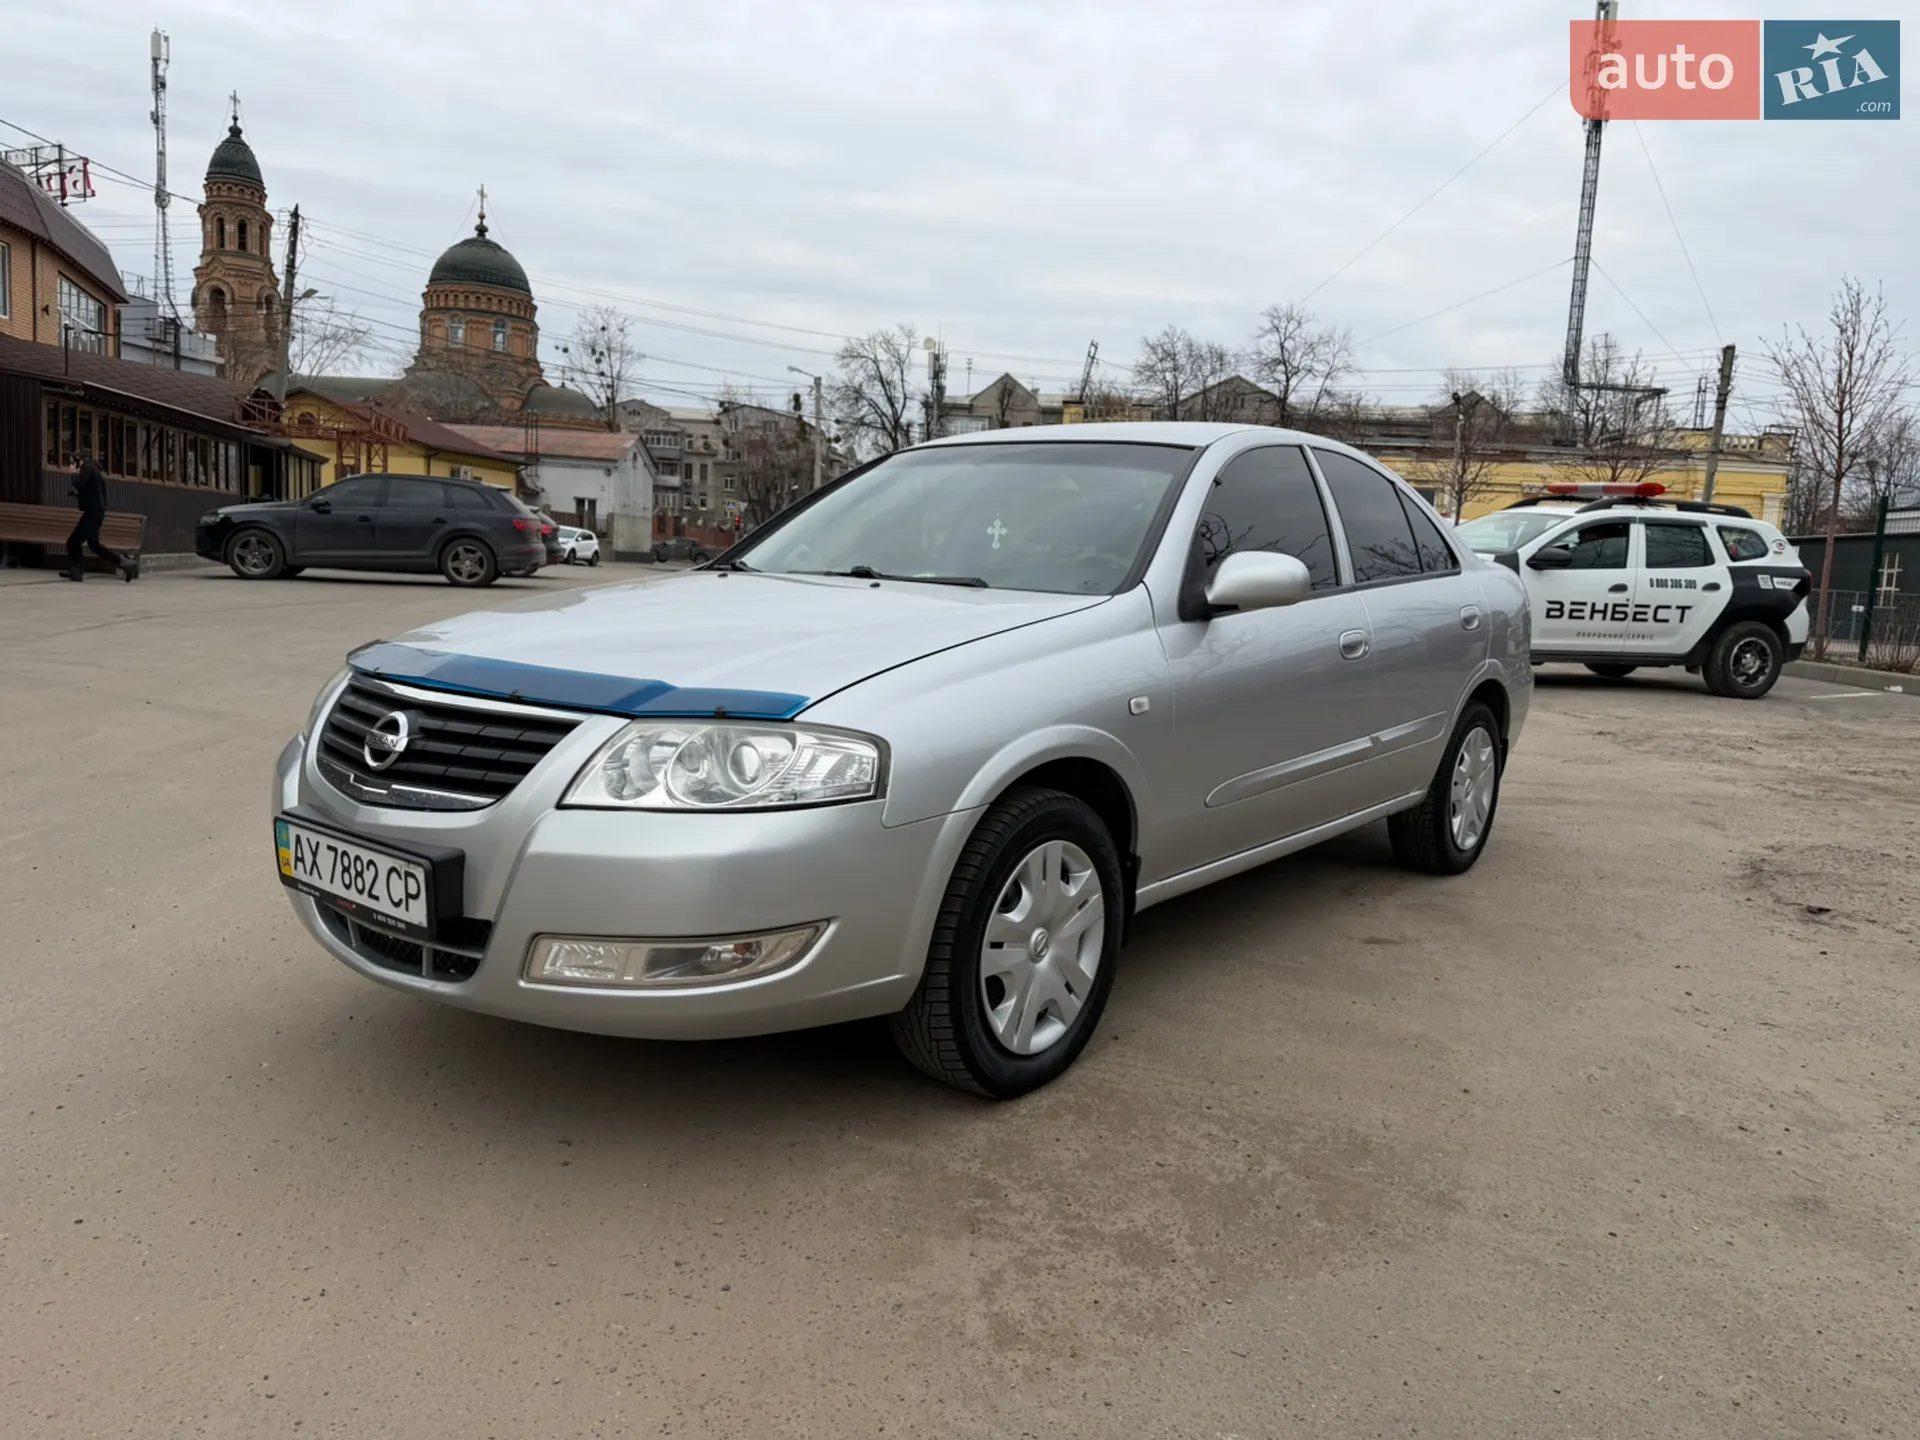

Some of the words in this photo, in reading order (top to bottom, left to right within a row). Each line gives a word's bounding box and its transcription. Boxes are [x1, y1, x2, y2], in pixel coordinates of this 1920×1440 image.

[1656, 577, 1669, 589] 800
[1545, 600, 1694, 623] ВЕНБЕСТ
[294, 833, 323, 881] AX
[326, 844, 380, 901] 7882
[386, 866, 421, 912] CP
